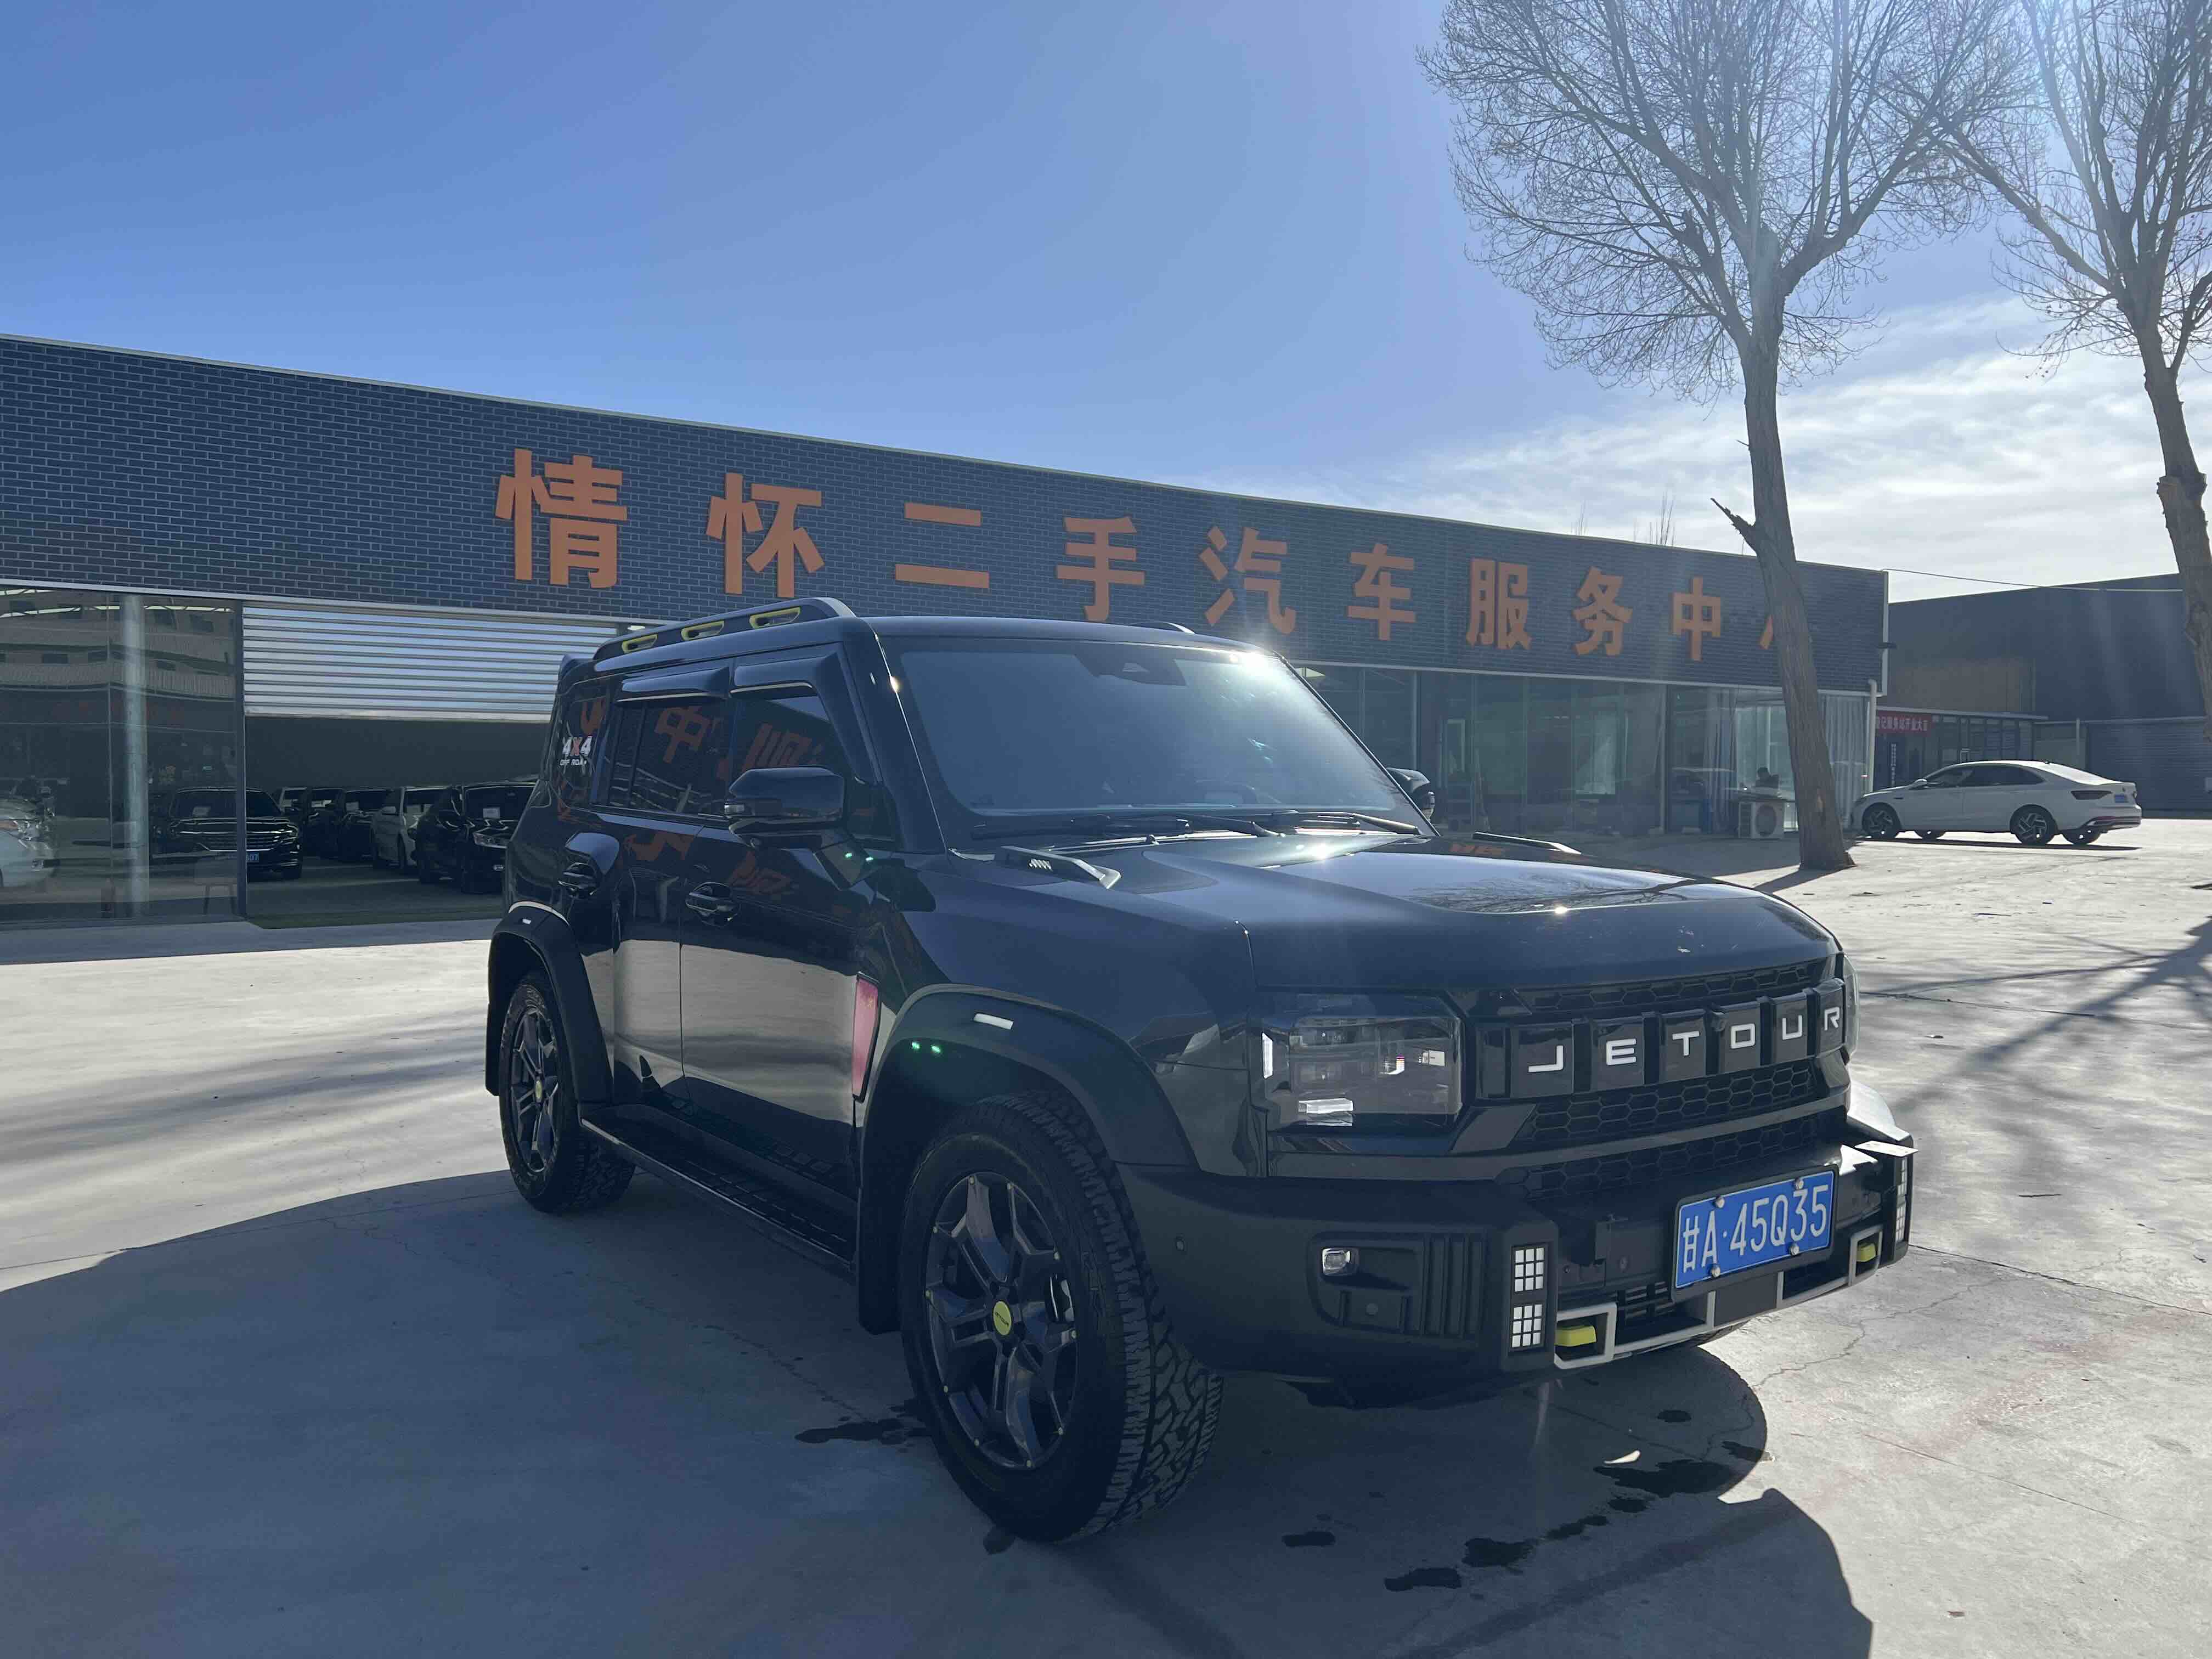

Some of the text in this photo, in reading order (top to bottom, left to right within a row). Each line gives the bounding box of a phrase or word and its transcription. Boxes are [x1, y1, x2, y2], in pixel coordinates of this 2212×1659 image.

[495, 448, 1774, 661] 情怀二手汽车服务中
[1528, 1006, 1840, 1073] JETOUR
